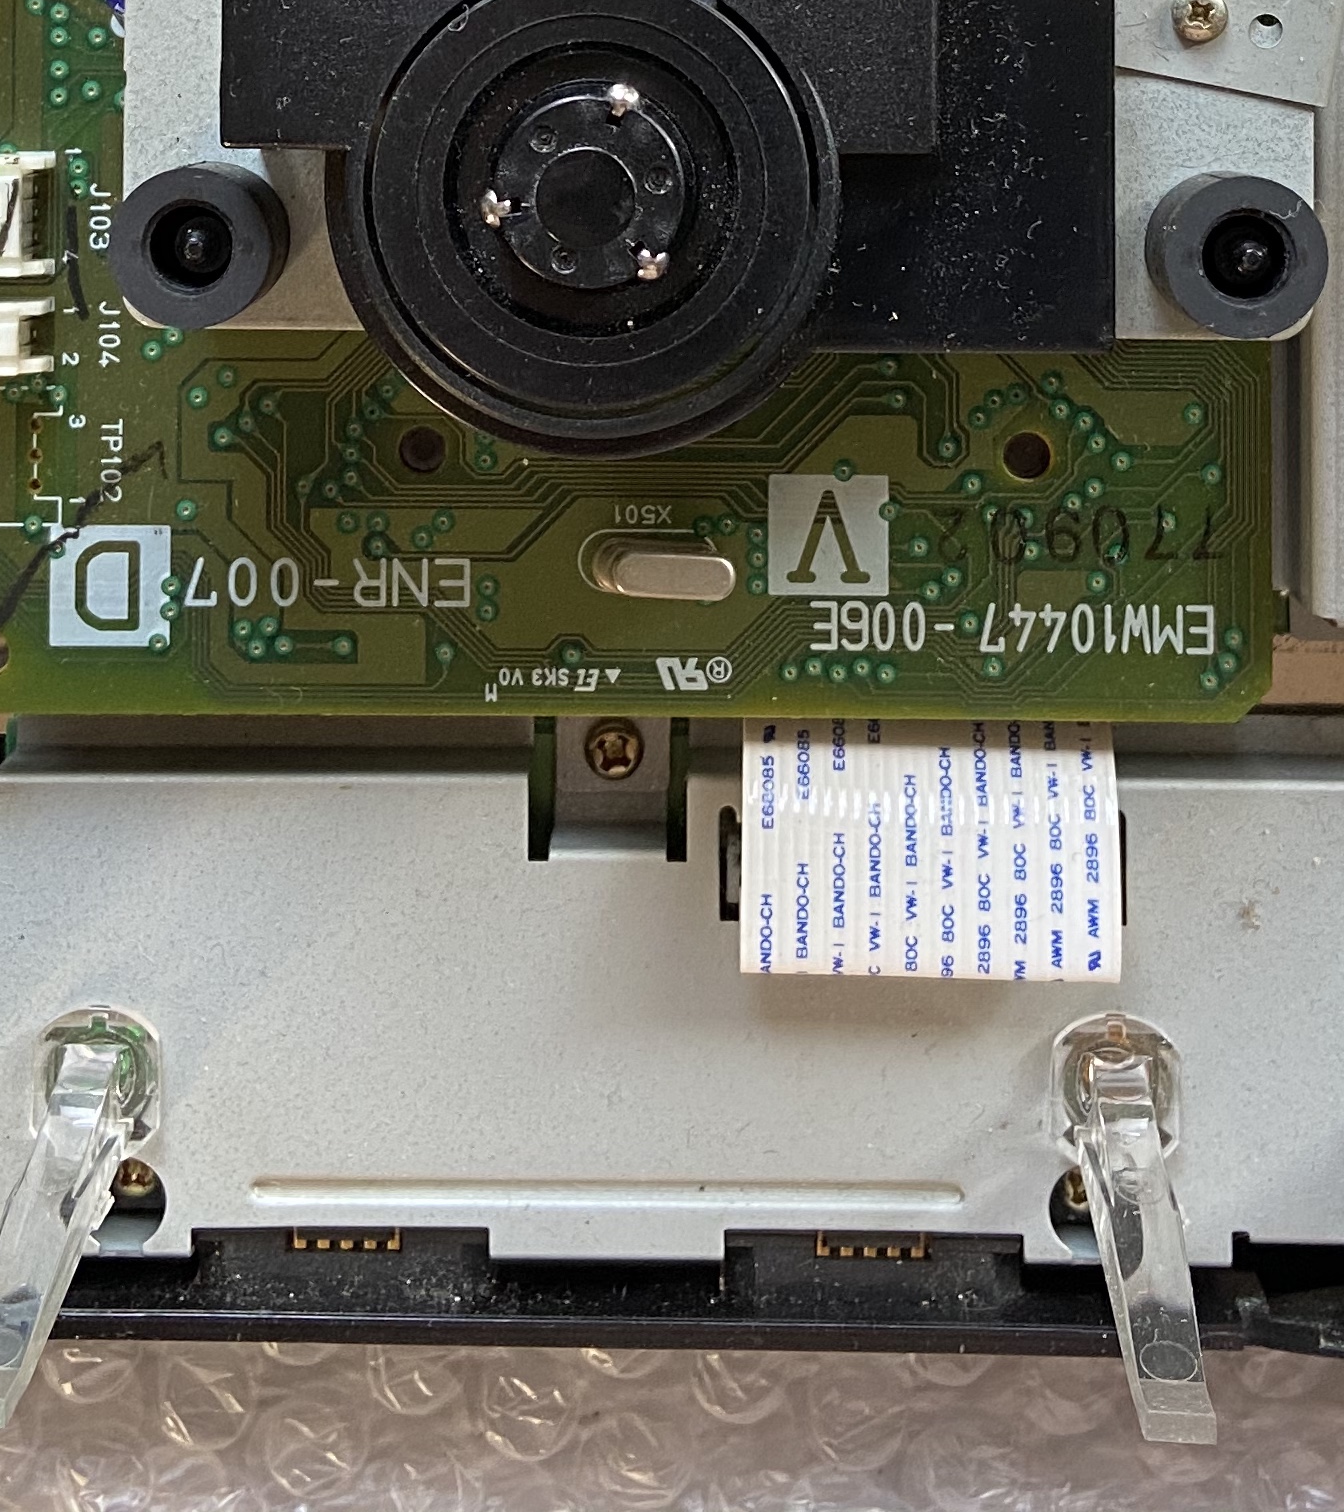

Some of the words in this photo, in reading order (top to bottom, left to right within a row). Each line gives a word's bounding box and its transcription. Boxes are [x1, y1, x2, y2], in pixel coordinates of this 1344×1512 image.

[88, 182, 112, 251] J103
[62, 352, 80, 367] 2
[98, 301, 122, 369] J104
[67, 414, 86, 429] 3
[101, 418, 124, 503] TP102
[612, 504, 673, 525] X501
[182, 556, 472, 608] ENR-007
[484, 682, 498, 702] M
[530, 667, 570, 687] SK3
[797, 729, 810, 800] E66085
[973, 722, 988, 807] BANDO-CH
[760, 755, 774, 830] E66085
[1083, 785, 1096, 821] 80C
[904, 775, 917, 867] BANDO-CH
[1049, 814, 1062, 851] 80C
[869, 803, 881, 898] BANDO-CH
[1013, 844, 1026, 881] 80C
[1086, 833, 1099, 883] 2896
[833, 833, 845, 928] BANDO-CH
[978, 873, 990, 912] 80C
[1050, 863, 1063, 914] 2896
[796, 863, 809, 959] BANDO-CH
[941, 905, 954, 943] 80C
[1014, 893, 1027, 945] 2896
[1087, 899, 1100, 939] AWM
[905, 936, 918, 972] 80C
[978, 925, 991, 974] 2896
[1051, 930, 1063, 969] AWM
